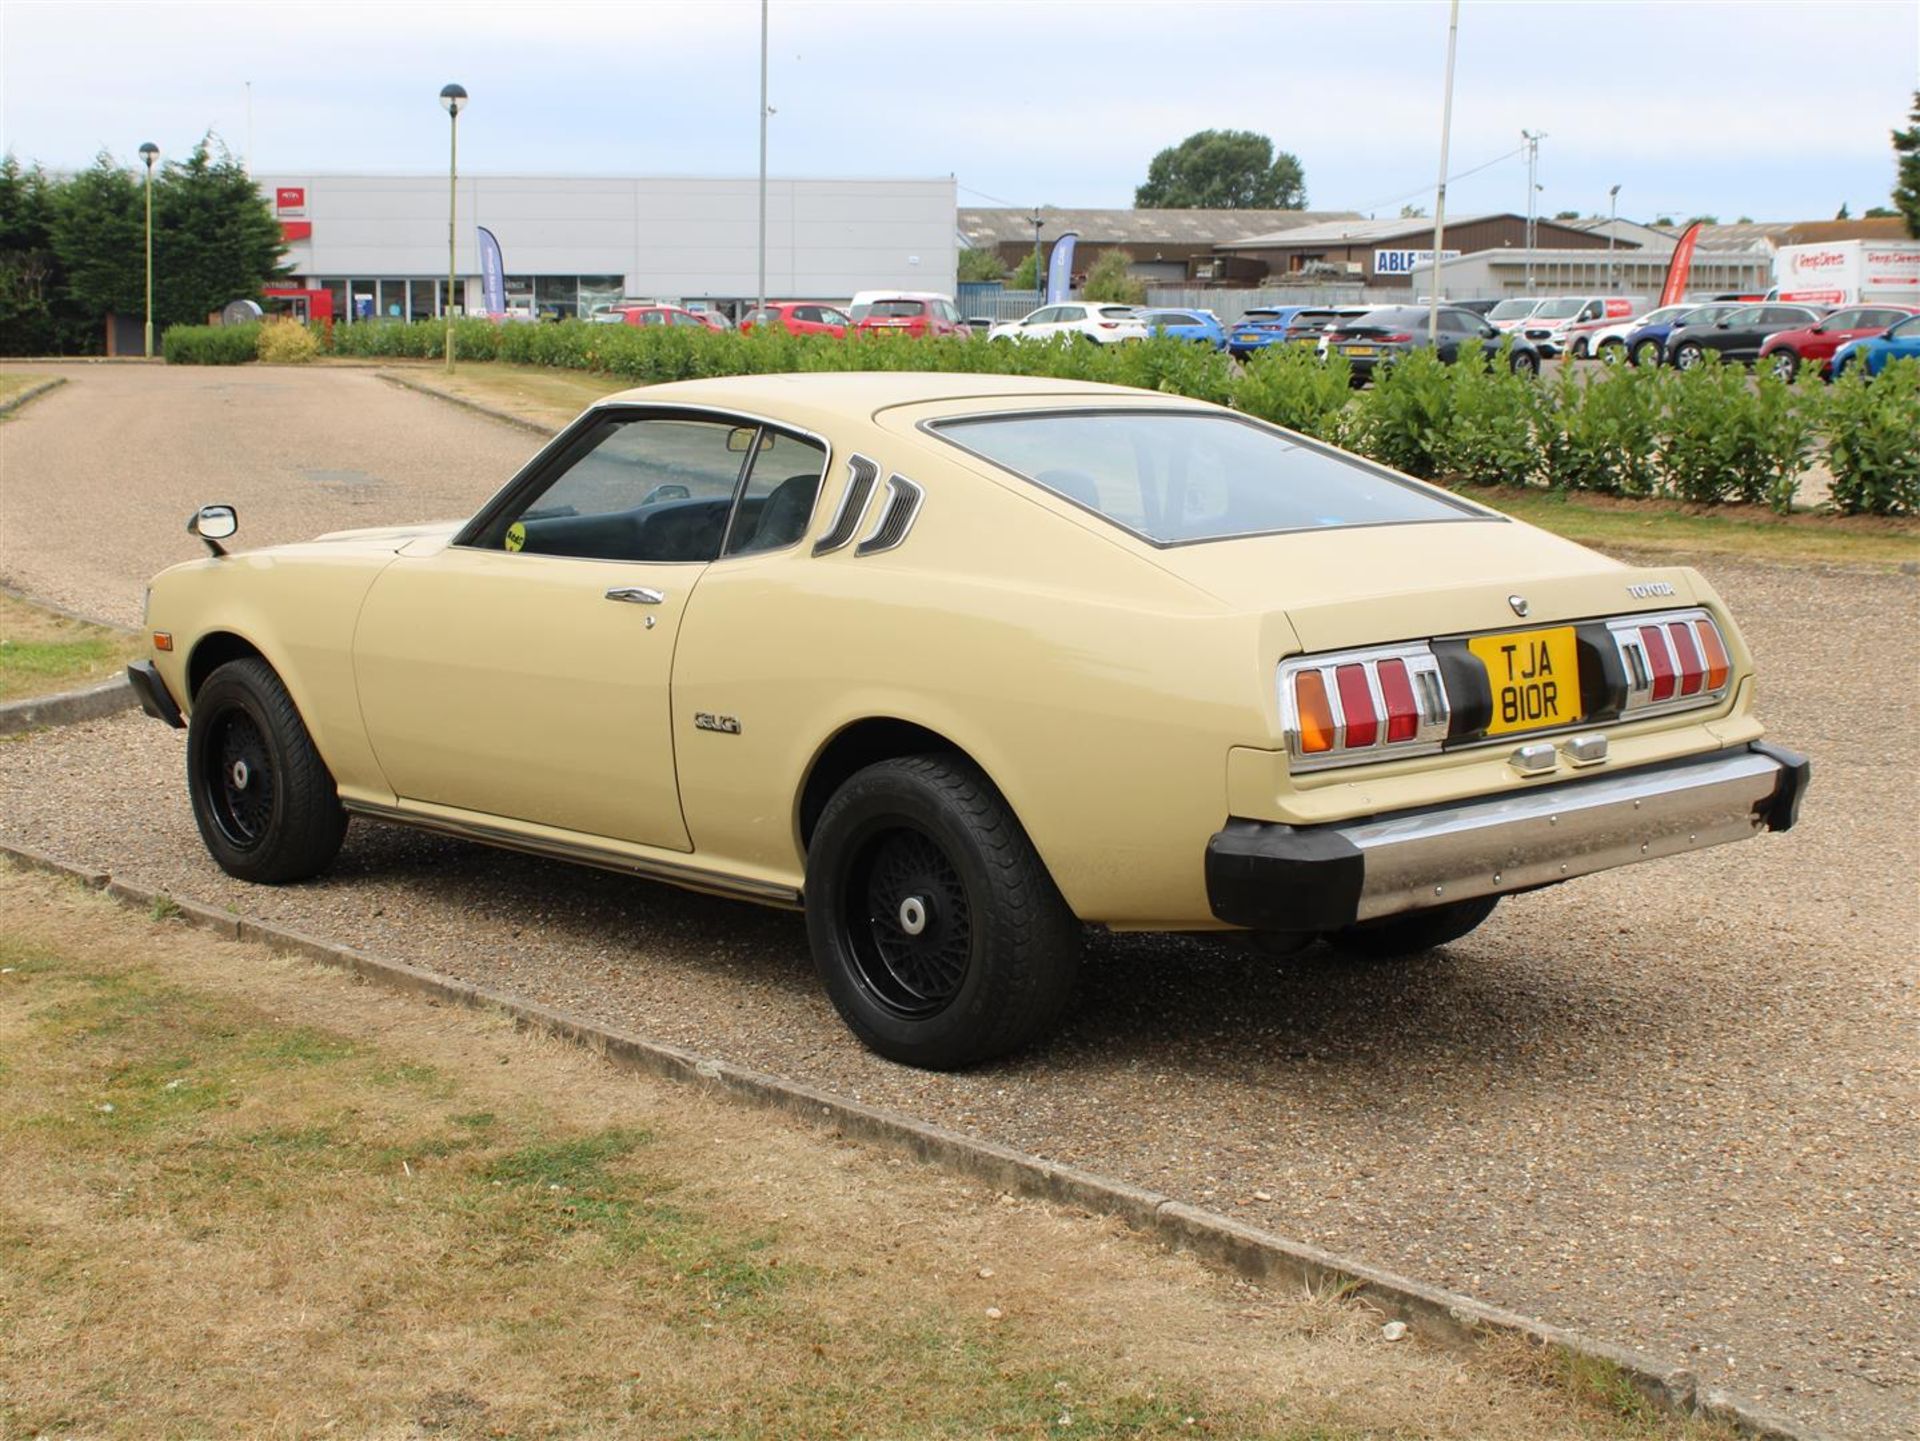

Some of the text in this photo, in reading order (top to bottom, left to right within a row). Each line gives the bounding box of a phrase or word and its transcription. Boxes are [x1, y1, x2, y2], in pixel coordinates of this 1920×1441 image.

[1627, 582, 1675, 599] TOYOTA
[1501, 639, 1552, 682] TJA
[1502, 682, 1558, 723] 810R
